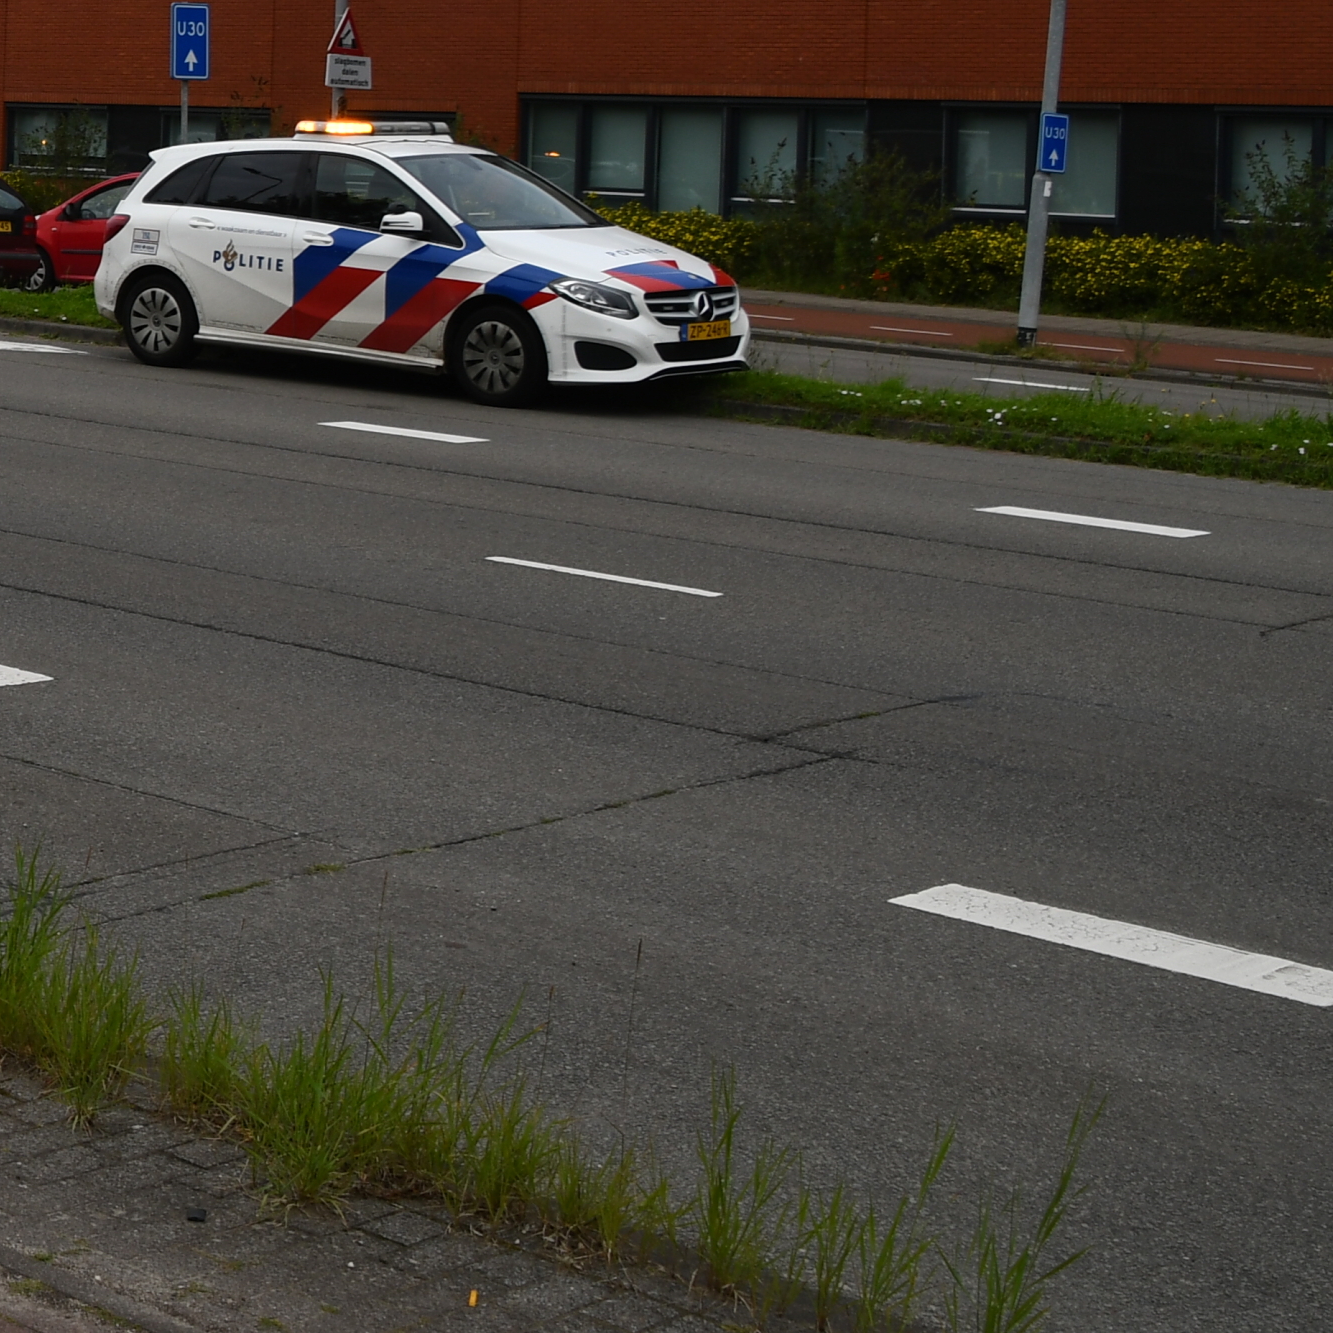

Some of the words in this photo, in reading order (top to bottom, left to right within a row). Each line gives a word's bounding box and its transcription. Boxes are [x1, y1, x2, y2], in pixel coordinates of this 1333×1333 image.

[177, 20, 205, 37] U30
[334, 57, 366, 67] slagbomen
[341, 68, 359, 76] dalen
[330, 77, 369, 87] automatisch
[1045, 126, 1066, 140] U30
[213, 249, 285, 272] POLITIE
[689, 322, 729, 339] ZP-246-R
